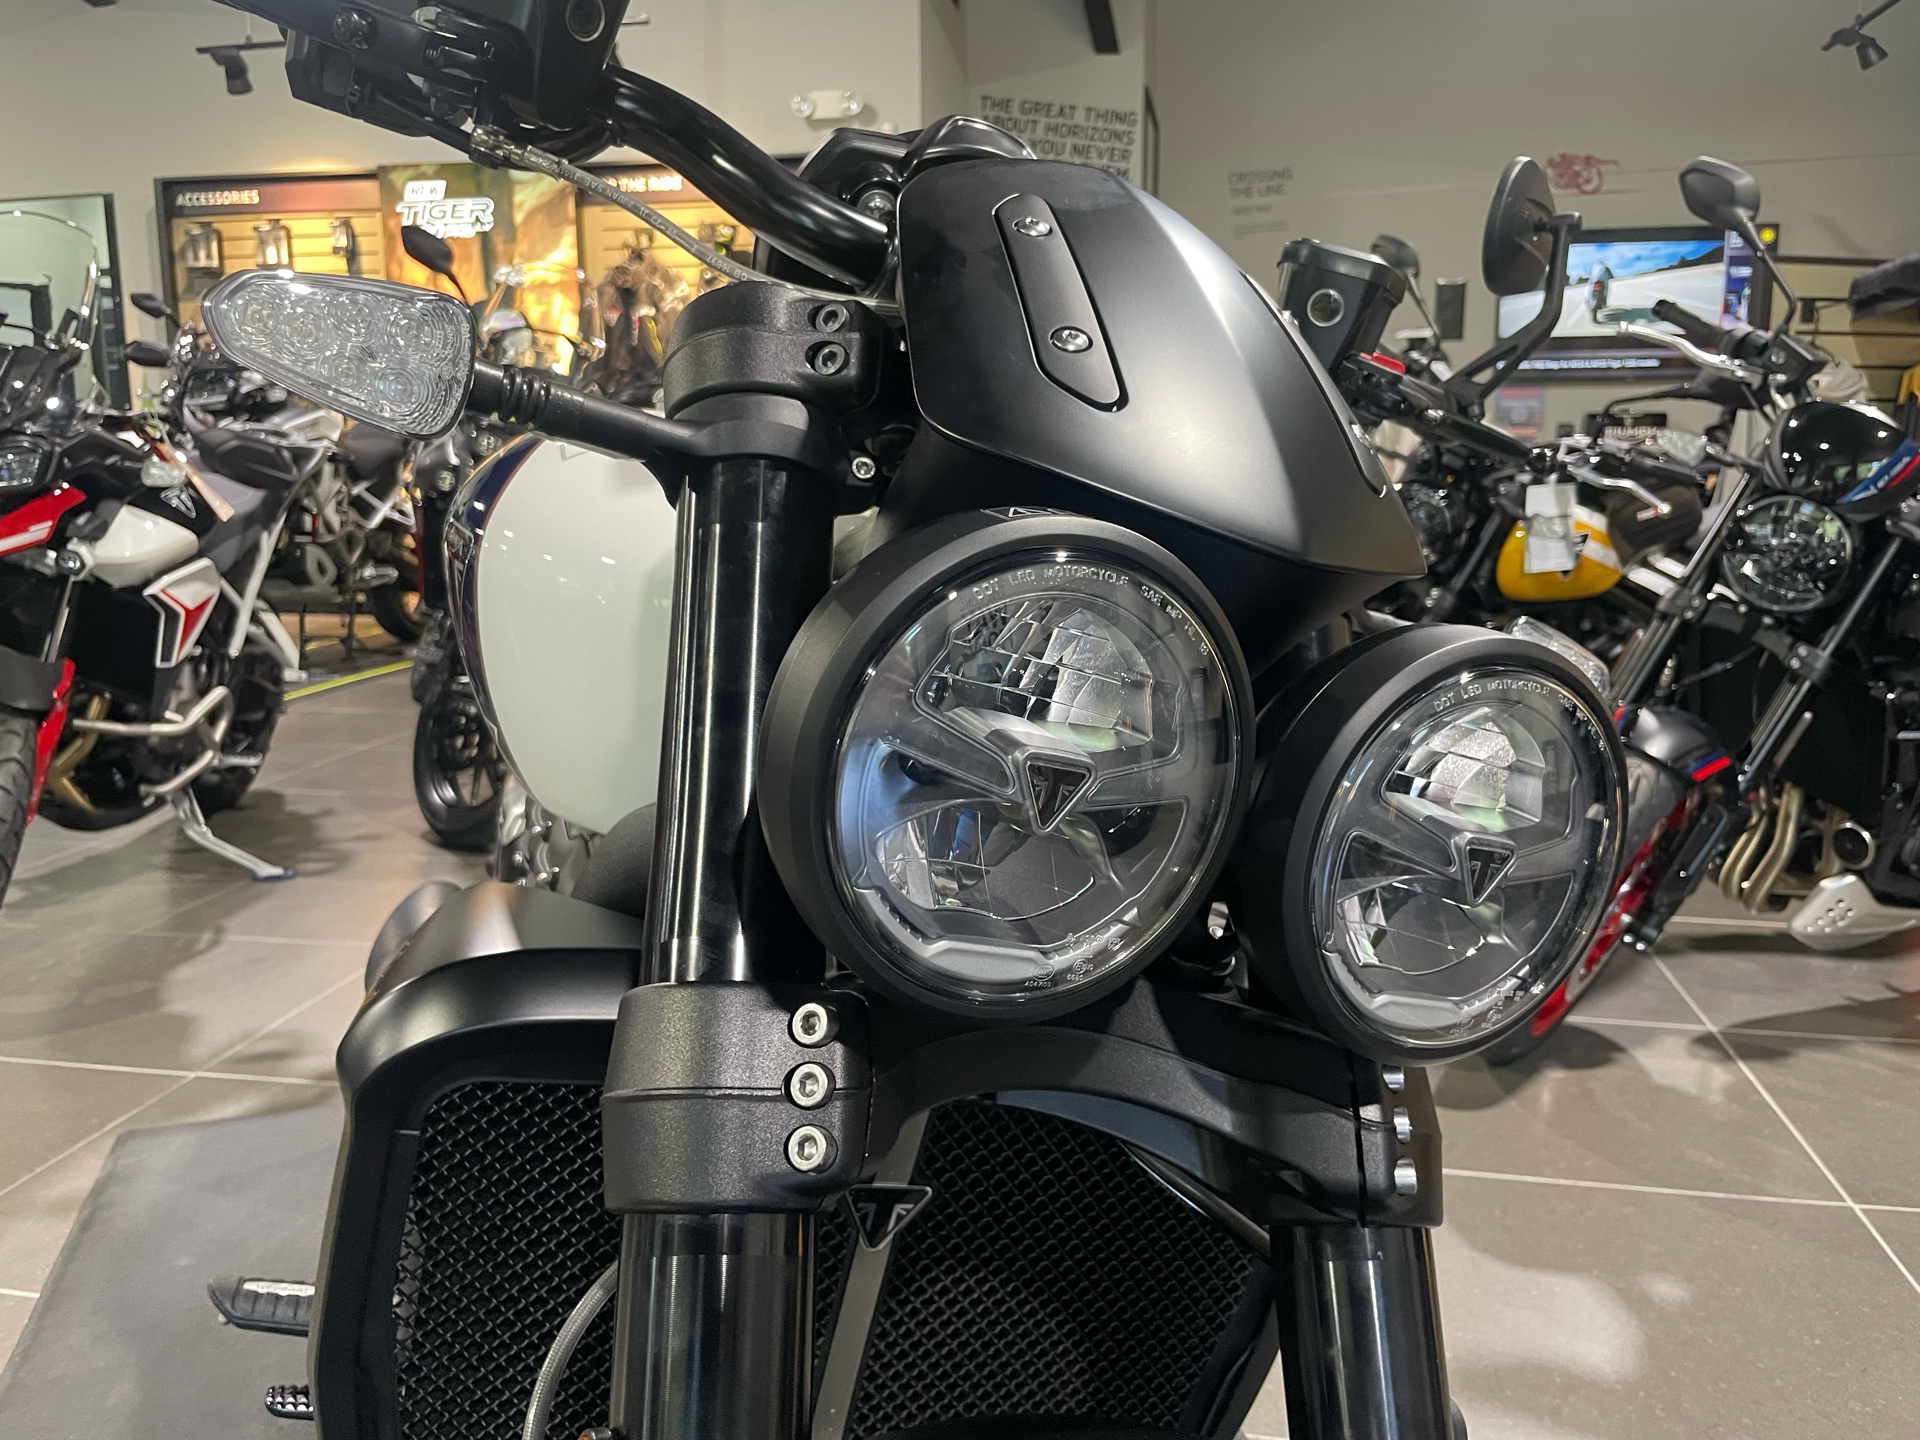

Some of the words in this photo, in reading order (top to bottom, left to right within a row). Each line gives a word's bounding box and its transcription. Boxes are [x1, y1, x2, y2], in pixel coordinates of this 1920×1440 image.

[981, 95, 1012, 113] THE
[1019, 100, 1077, 120] GREAT
[1083, 107, 1138, 128] THING
[1043, 123, 1137, 147] HORIZONS
[1070, 142, 1132, 163] NEVER
[176, 189, 260, 206] ACCESSORIES
[395, 198, 494, 226] TIGER
[972, 578, 1000, 600] DOT
[1008, 569, 1036, 585] LED
[1043, 565, 1129, 588] MOTORCYCLE
[1433, 692, 1455, 712] DOT
[1460, 684, 1482, 700] LED
